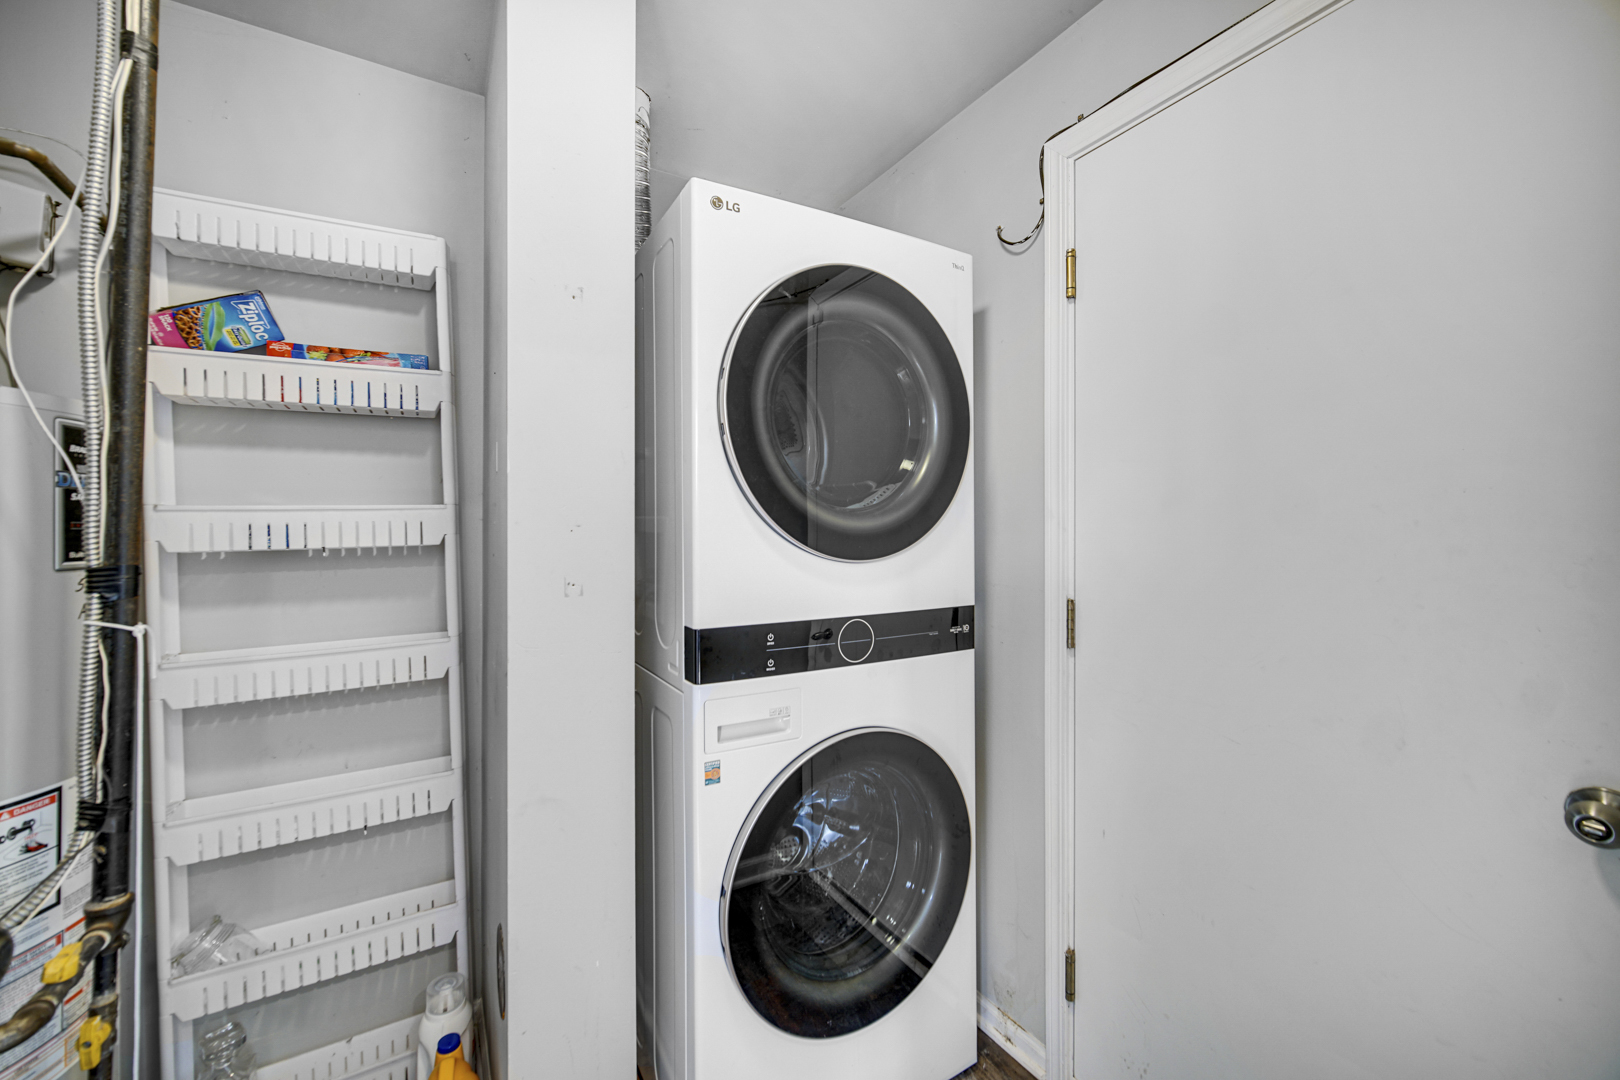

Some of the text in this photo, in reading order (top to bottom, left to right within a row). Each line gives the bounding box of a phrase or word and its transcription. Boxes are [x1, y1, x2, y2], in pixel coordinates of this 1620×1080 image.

[726, 200, 740, 213] LG
[238, 302, 268, 340] Ziploc
[13, 798, 51, 816] DANGER
